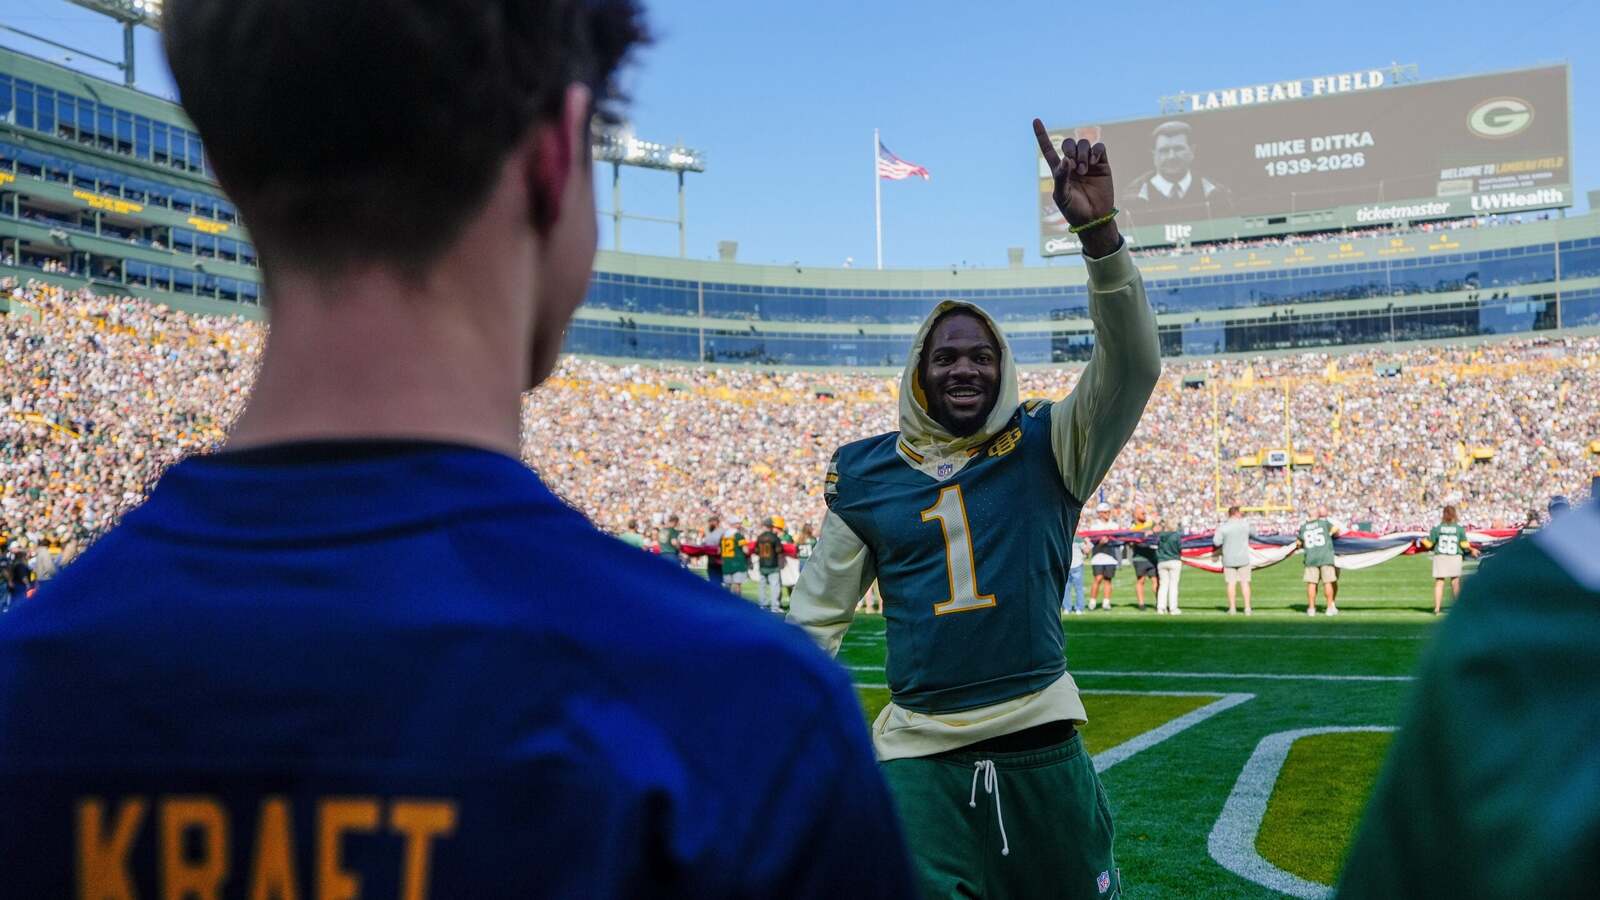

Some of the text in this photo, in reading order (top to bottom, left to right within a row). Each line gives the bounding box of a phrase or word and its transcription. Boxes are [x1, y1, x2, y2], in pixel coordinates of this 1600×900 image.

[1191, 71, 1384, 111] LAMBEAU FIELD
[1255, 131, 1375, 159] MIKE DITKA
[1265, 152, 1366, 177] 1939-2026
[1356, 202, 1450, 222] ticketmaster
[1164, 224, 1193, 243] Lite
[721, 536, 735, 558] 12
[921, 484, 996, 616] 1
[1303, 527, 1326, 548] 85
[75, 795, 458, 900] KRAFT
